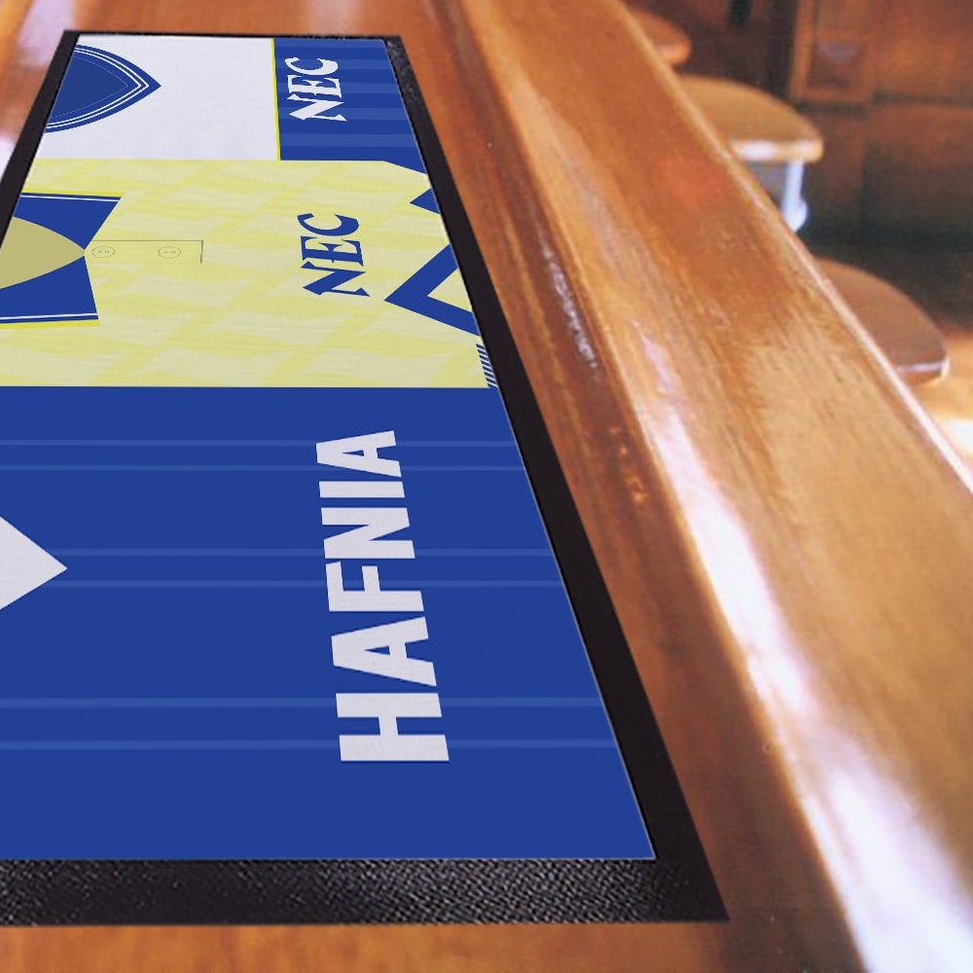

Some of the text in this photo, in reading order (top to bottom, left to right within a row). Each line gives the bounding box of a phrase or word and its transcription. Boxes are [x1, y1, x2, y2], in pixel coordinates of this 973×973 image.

[284, 57, 347, 122] NEC
[297, 213, 370, 297] NEC
[315, 429, 450, 762] HAFNIA
